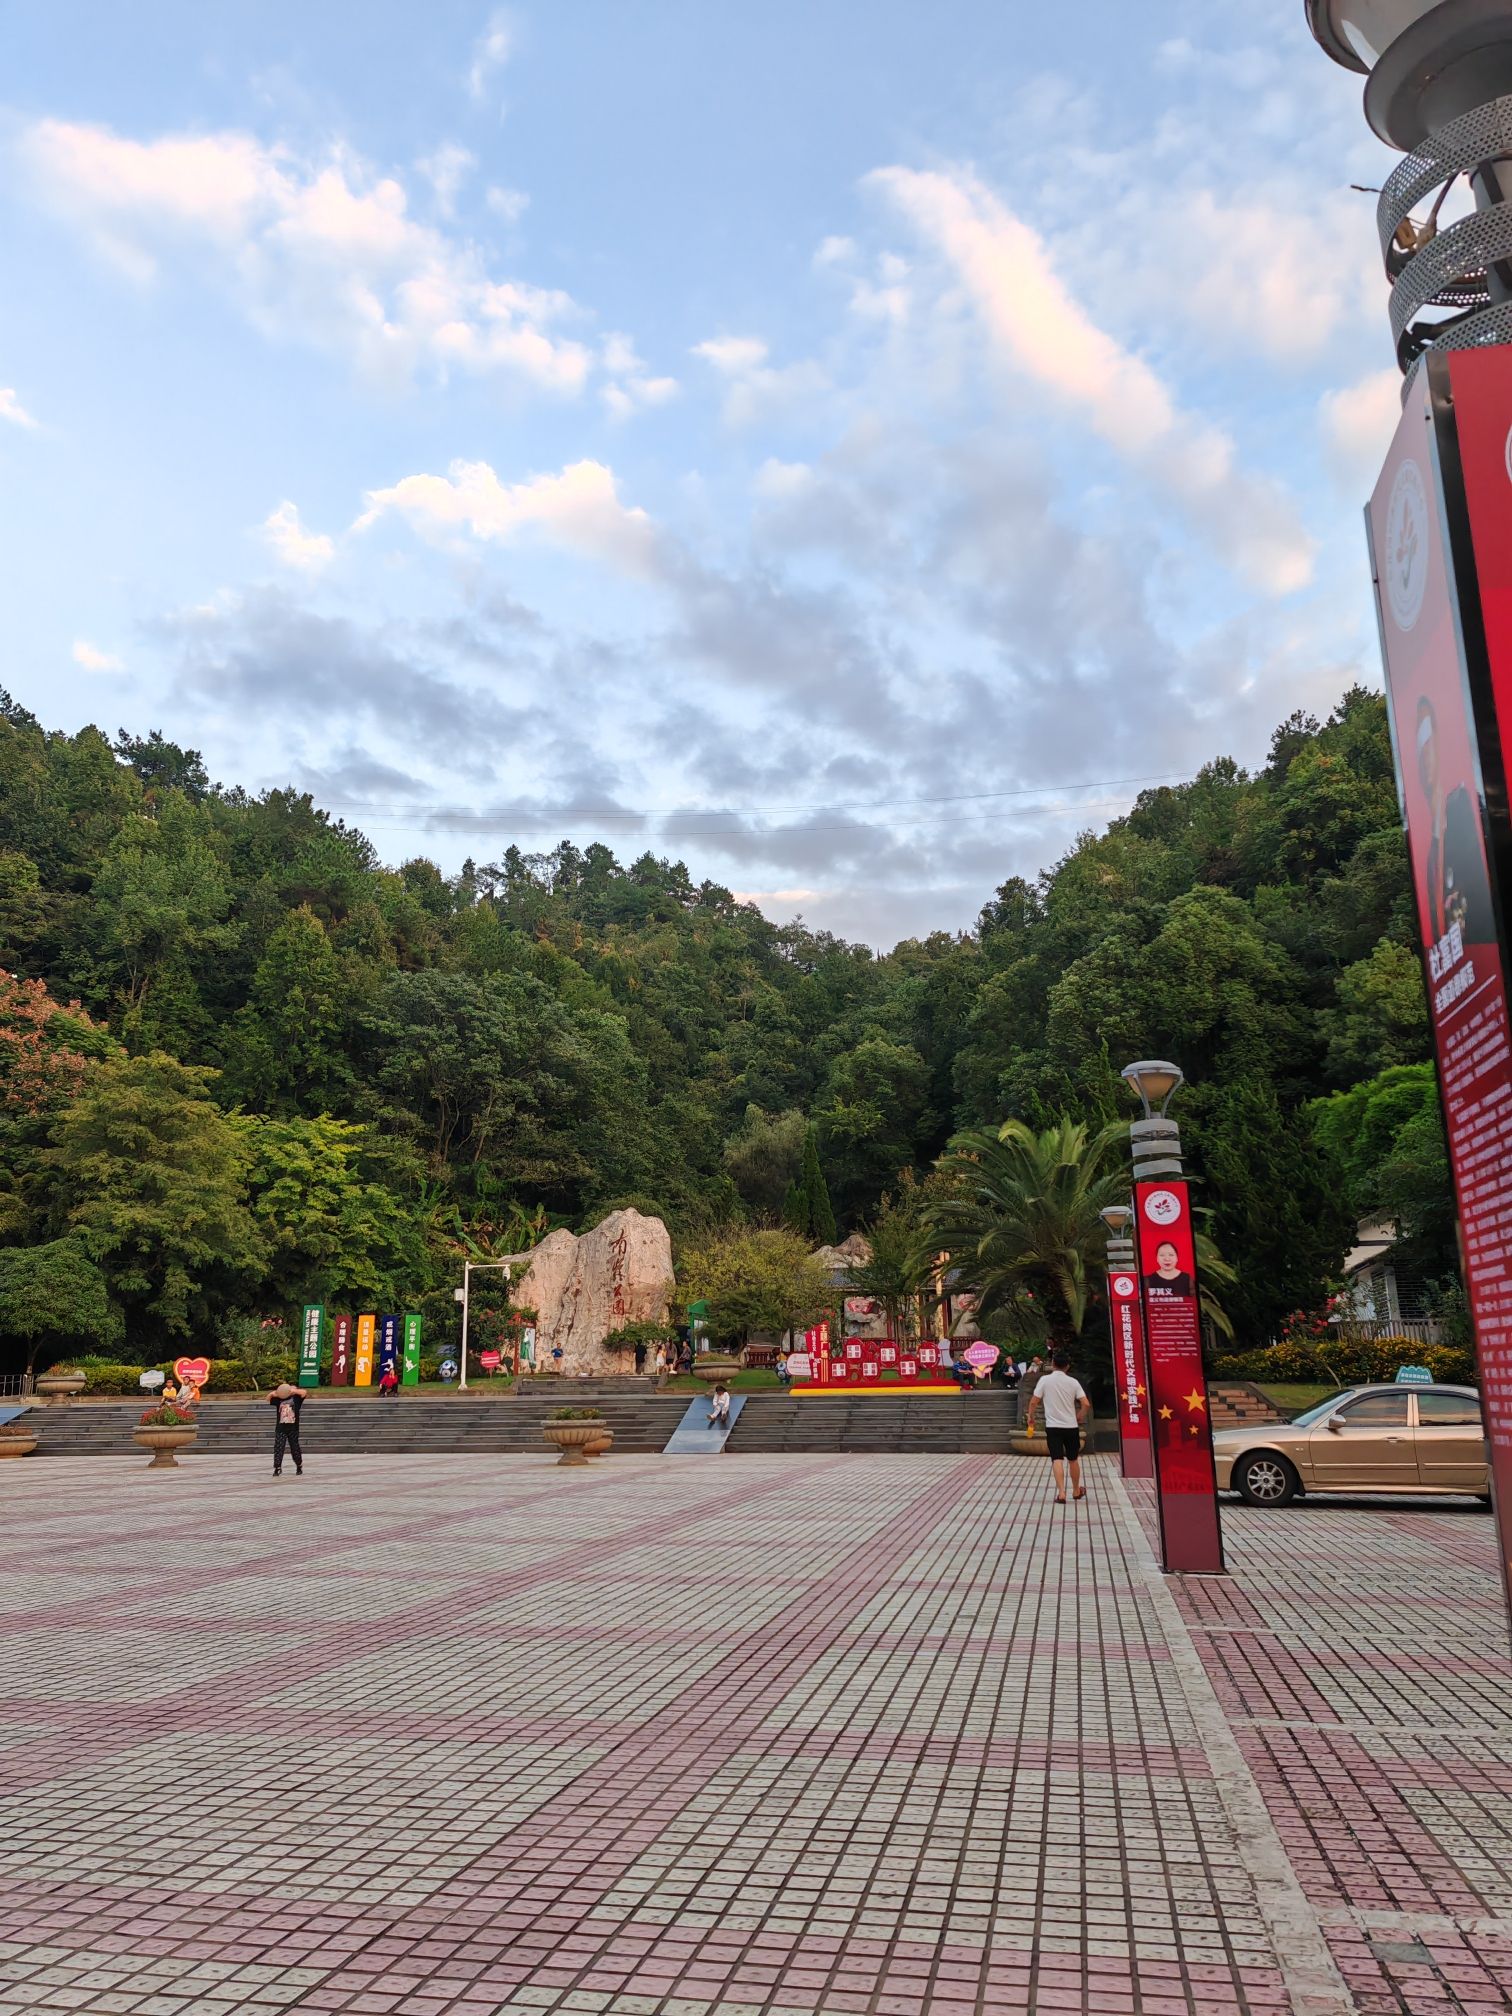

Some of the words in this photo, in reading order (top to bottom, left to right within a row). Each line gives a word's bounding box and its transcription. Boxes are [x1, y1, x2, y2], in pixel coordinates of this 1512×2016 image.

[309, 1309, 320, 1358] 健康主题公园
[338, 1321, 347, 1352] 合理膳食
[408, 1320, 417, 1351] 心理平衡
[1120, 1305, 1140, 1423] 红花岗区新时代文明实践广场
